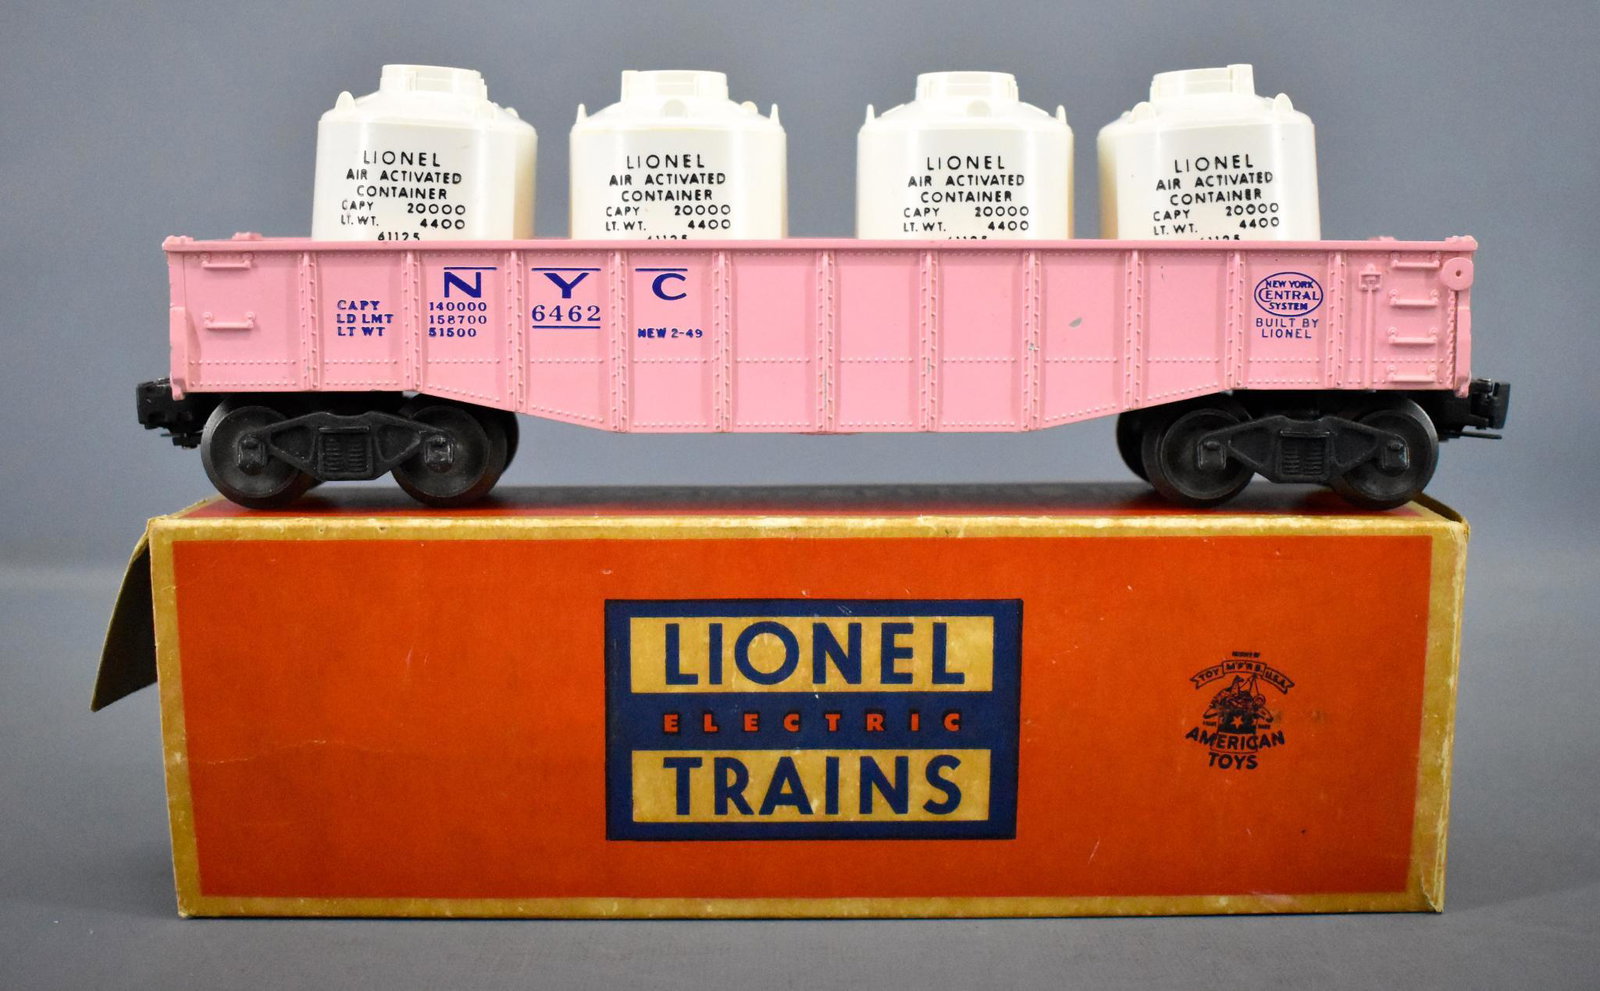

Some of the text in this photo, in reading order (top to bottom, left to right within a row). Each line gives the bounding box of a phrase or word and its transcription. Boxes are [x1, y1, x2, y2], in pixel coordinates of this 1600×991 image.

[364, 151, 440, 167] LIONEL
[627, 154, 704, 169] LIONEL
[928, 156, 1004, 170] LIONEL
[1175, 154, 1254, 174] LIONEL
[347, 169, 461, 184] AIR ACTIVATED
[610, 173, 725, 186] AIR ACTIVATED
[909, 175, 1024, 186] AIR ACTIVATED
[1157, 172, 1272, 190] AIR ACTIVATED
[357, 186, 446, 199] CONTAINER
[622, 189, 712, 202] CONTAINER
[921, 191, 1011, 203] CONTAINER
[1170, 188, 1262, 206] CONTAINER
[342, 200, 465, 215] CAPY 20000
[606, 205, 730, 217] CAPY 20000
[904, 206, 1028, 217] CAPY 20000
[1154, 203, 1278, 221] CAPY 20000
[341, 215, 465, 229] LT. WT. 4400
[606, 219, 730, 231] LT. WT. 4400
[904, 221, 1028, 232] LT. WT. 4400
[1154, 217, 1278, 235] LT. WT. 4400
[444, 272, 686, 300] N Y C
[1266, 280, 1314, 288] NEW YORK
[1259, 288, 1319, 302] CENTRAL
[338, 300, 486, 311] CAPY 140000
[1268, 302, 1308, 311] SYSTEM
[337, 314, 486, 324] LD LMT 158700
[532, 305, 600, 322] 6462
[1256, 318, 1318, 328] BUILT BY
[338, 327, 476, 337] LT WT 51500
[638, 328, 702, 338] NEW 2-49
[1262, 329, 1311, 338] LIONEL
[665, 621, 965, 685] LIONEL
[1200, 668, 1219, 681] TOY
[663, 712, 961, 732] ELECTRIC
[1186, 727, 1284, 750] AMERICAN
[1209, 752, 1258, 769] TOYS
[663, 755, 961, 815] TRAINS
